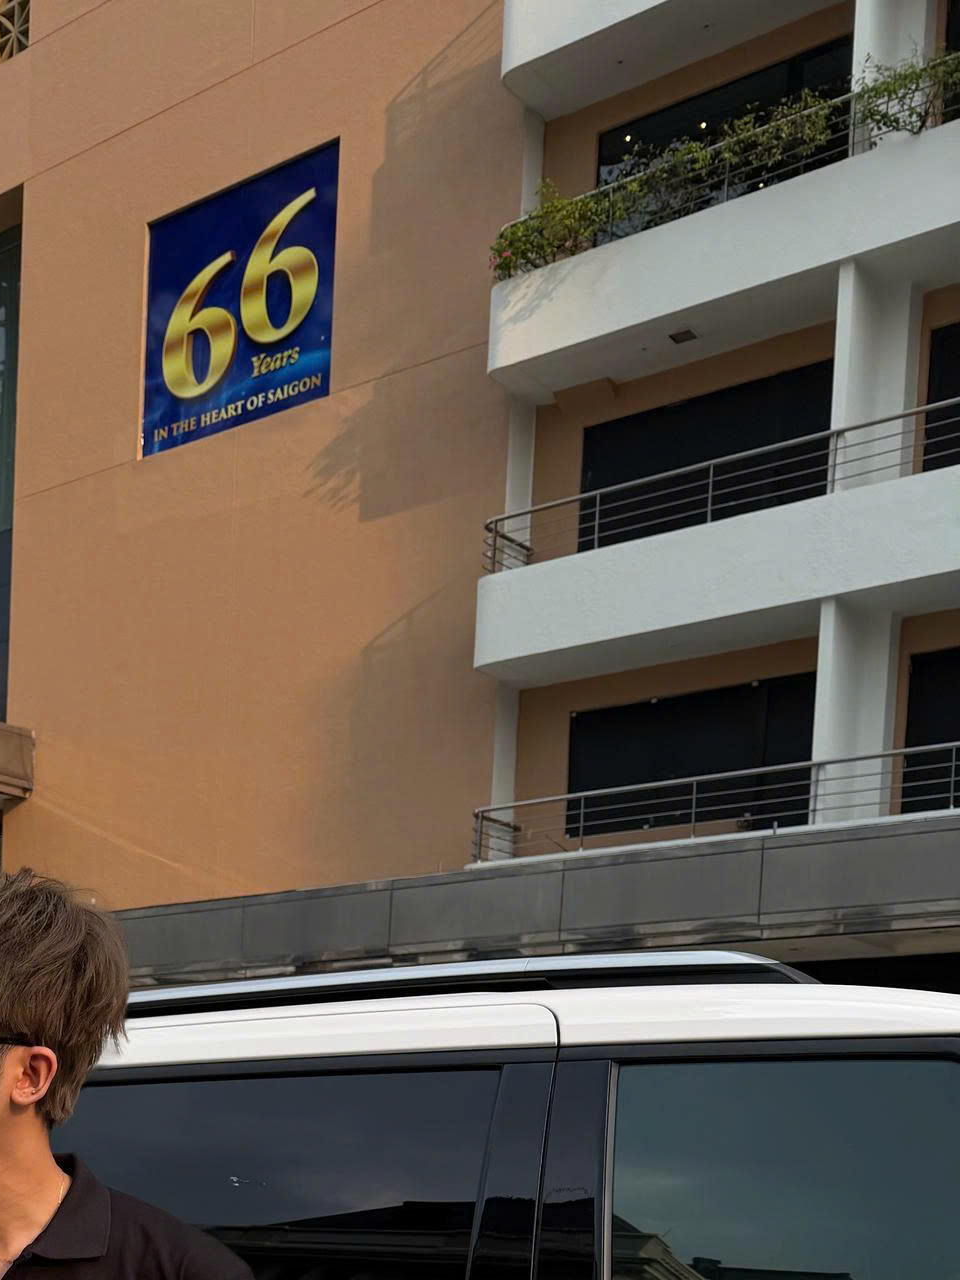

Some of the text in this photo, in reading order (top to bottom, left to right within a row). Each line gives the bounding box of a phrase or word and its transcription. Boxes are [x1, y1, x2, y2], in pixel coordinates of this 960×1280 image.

[161, 187, 319, 398] 66
[251, 346, 300, 378] Years
[153, 373, 323, 442] IN THE HEART OF SAIGON
